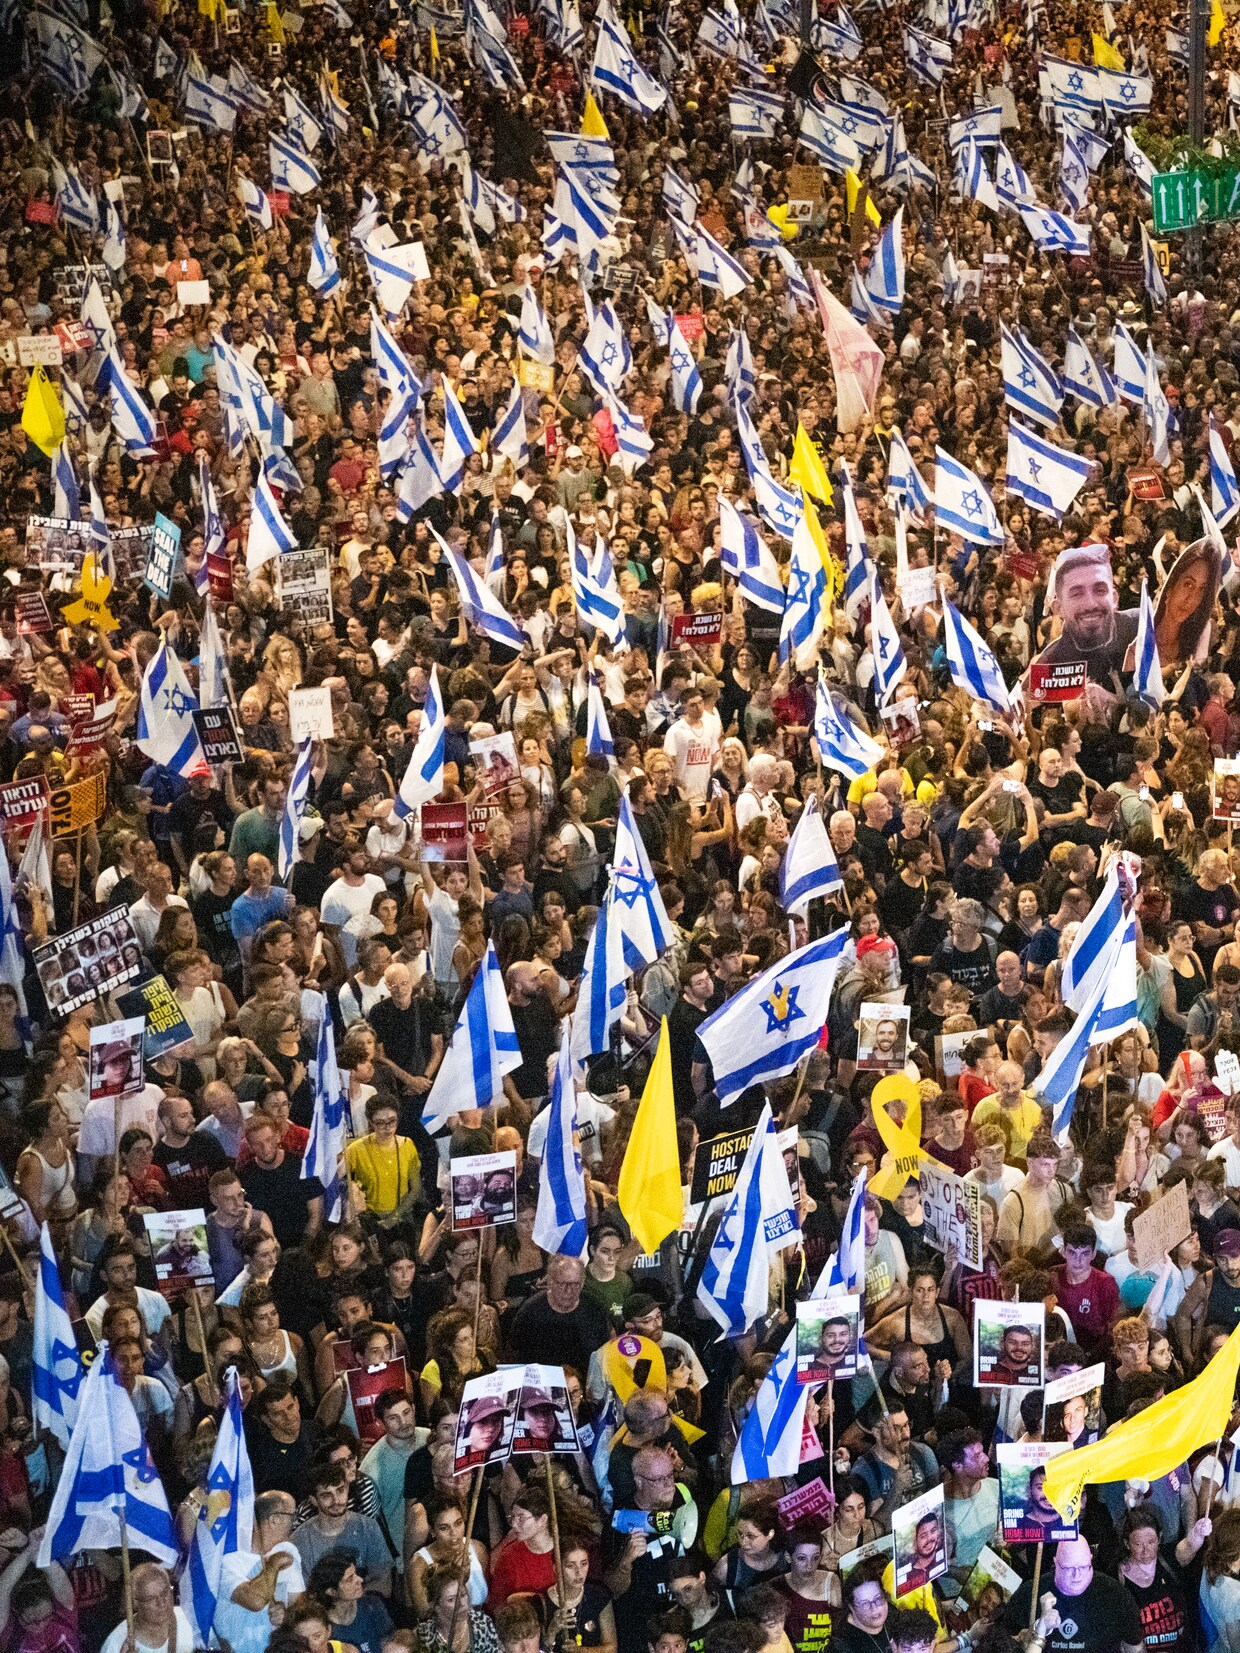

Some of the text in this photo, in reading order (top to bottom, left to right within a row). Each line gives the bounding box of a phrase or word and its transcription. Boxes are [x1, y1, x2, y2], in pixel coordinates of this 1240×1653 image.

[153, 549, 173, 572] THE
[146, 570, 170, 594] DEAL
[694, 614, 721, 626] לא נשכח,
[682, 624, 720, 636] לא נסלח!
[1052, 664, 1084, 676] לא נשכח,
[1040, 677, 1083, 688] לא נסלח!
[204, 716, 222, 729] עם
[2, 781, 40, 797] לדראון
[141, 980, 166, 999] איפה
[150, 990, 173, 1008] היית
[145, 1012, 184, 1037] הופקרו?
[712, 1135, 754, 1159] HOSTAG
[709, 1158, 737, 1178] DEAL
[895, 1155, 918, 1174] NOW
[707, 1174, 736, 1196] NOW
[929, 1170, 964, 1205] STOP
[764, 1211, 790, 1228] חופשי
[936, 1204, 957, 1234] THE
[783, 1482, 822, 1510] ממשלת
[787, 1494, 824, 1521] הורגת
[1004, 1508, 1024, 1519] BRING
[1004, 1518, 1017, 1528] HIM
[1004, 1528, 1044, 1538] HOME NOW!
